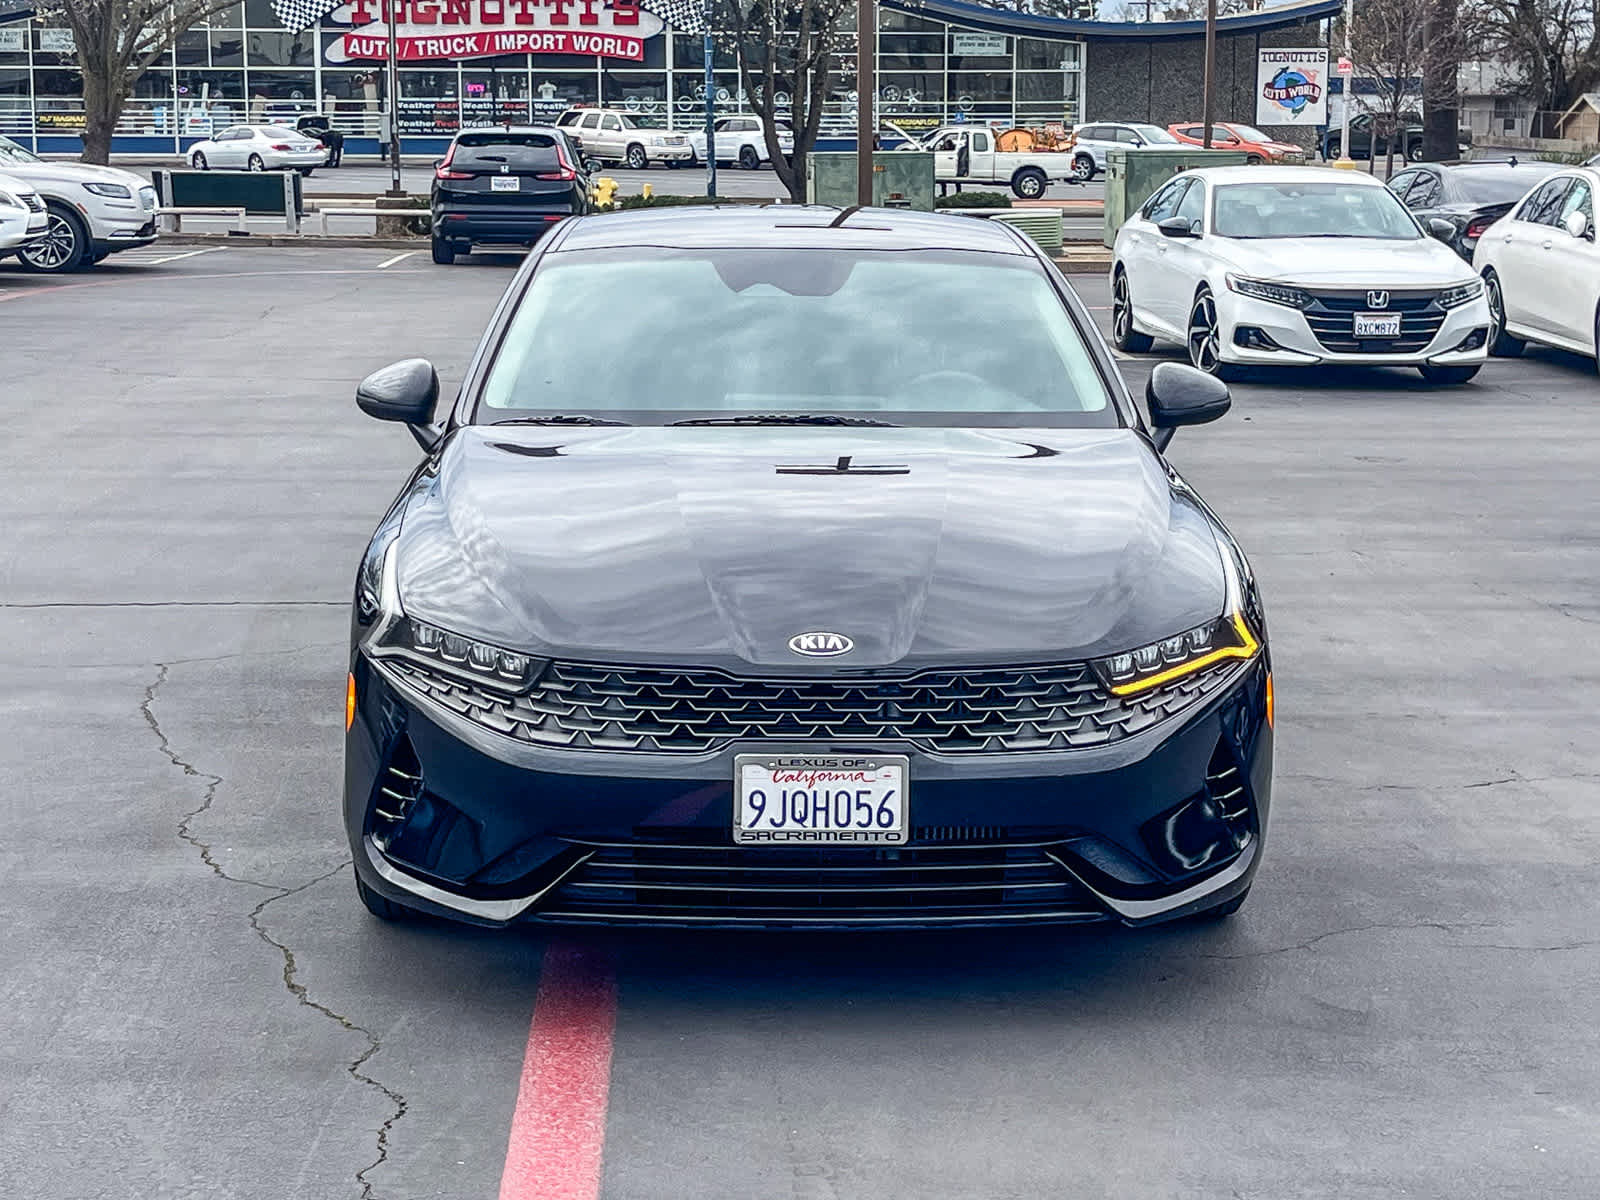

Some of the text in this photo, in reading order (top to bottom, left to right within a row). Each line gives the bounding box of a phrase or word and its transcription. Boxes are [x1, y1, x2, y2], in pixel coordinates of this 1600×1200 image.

[348, 38, 399, 56] AUTO
[415, 36, 479, 56] TRUCK
[495, 34, 566, 51] IMPORT
[572, 36, 640, 57] WORLD
[1264, 84, 1320, 100] AUTO WORLD
[800, 635, 844, 650] KIA
[778, 758, 866, 767] LEXUS OF
[772, 768, 876, 789] California
[747, 789, 896, 829] 9JQH056
[740, 831, 901, 842] SACRAMENTO
